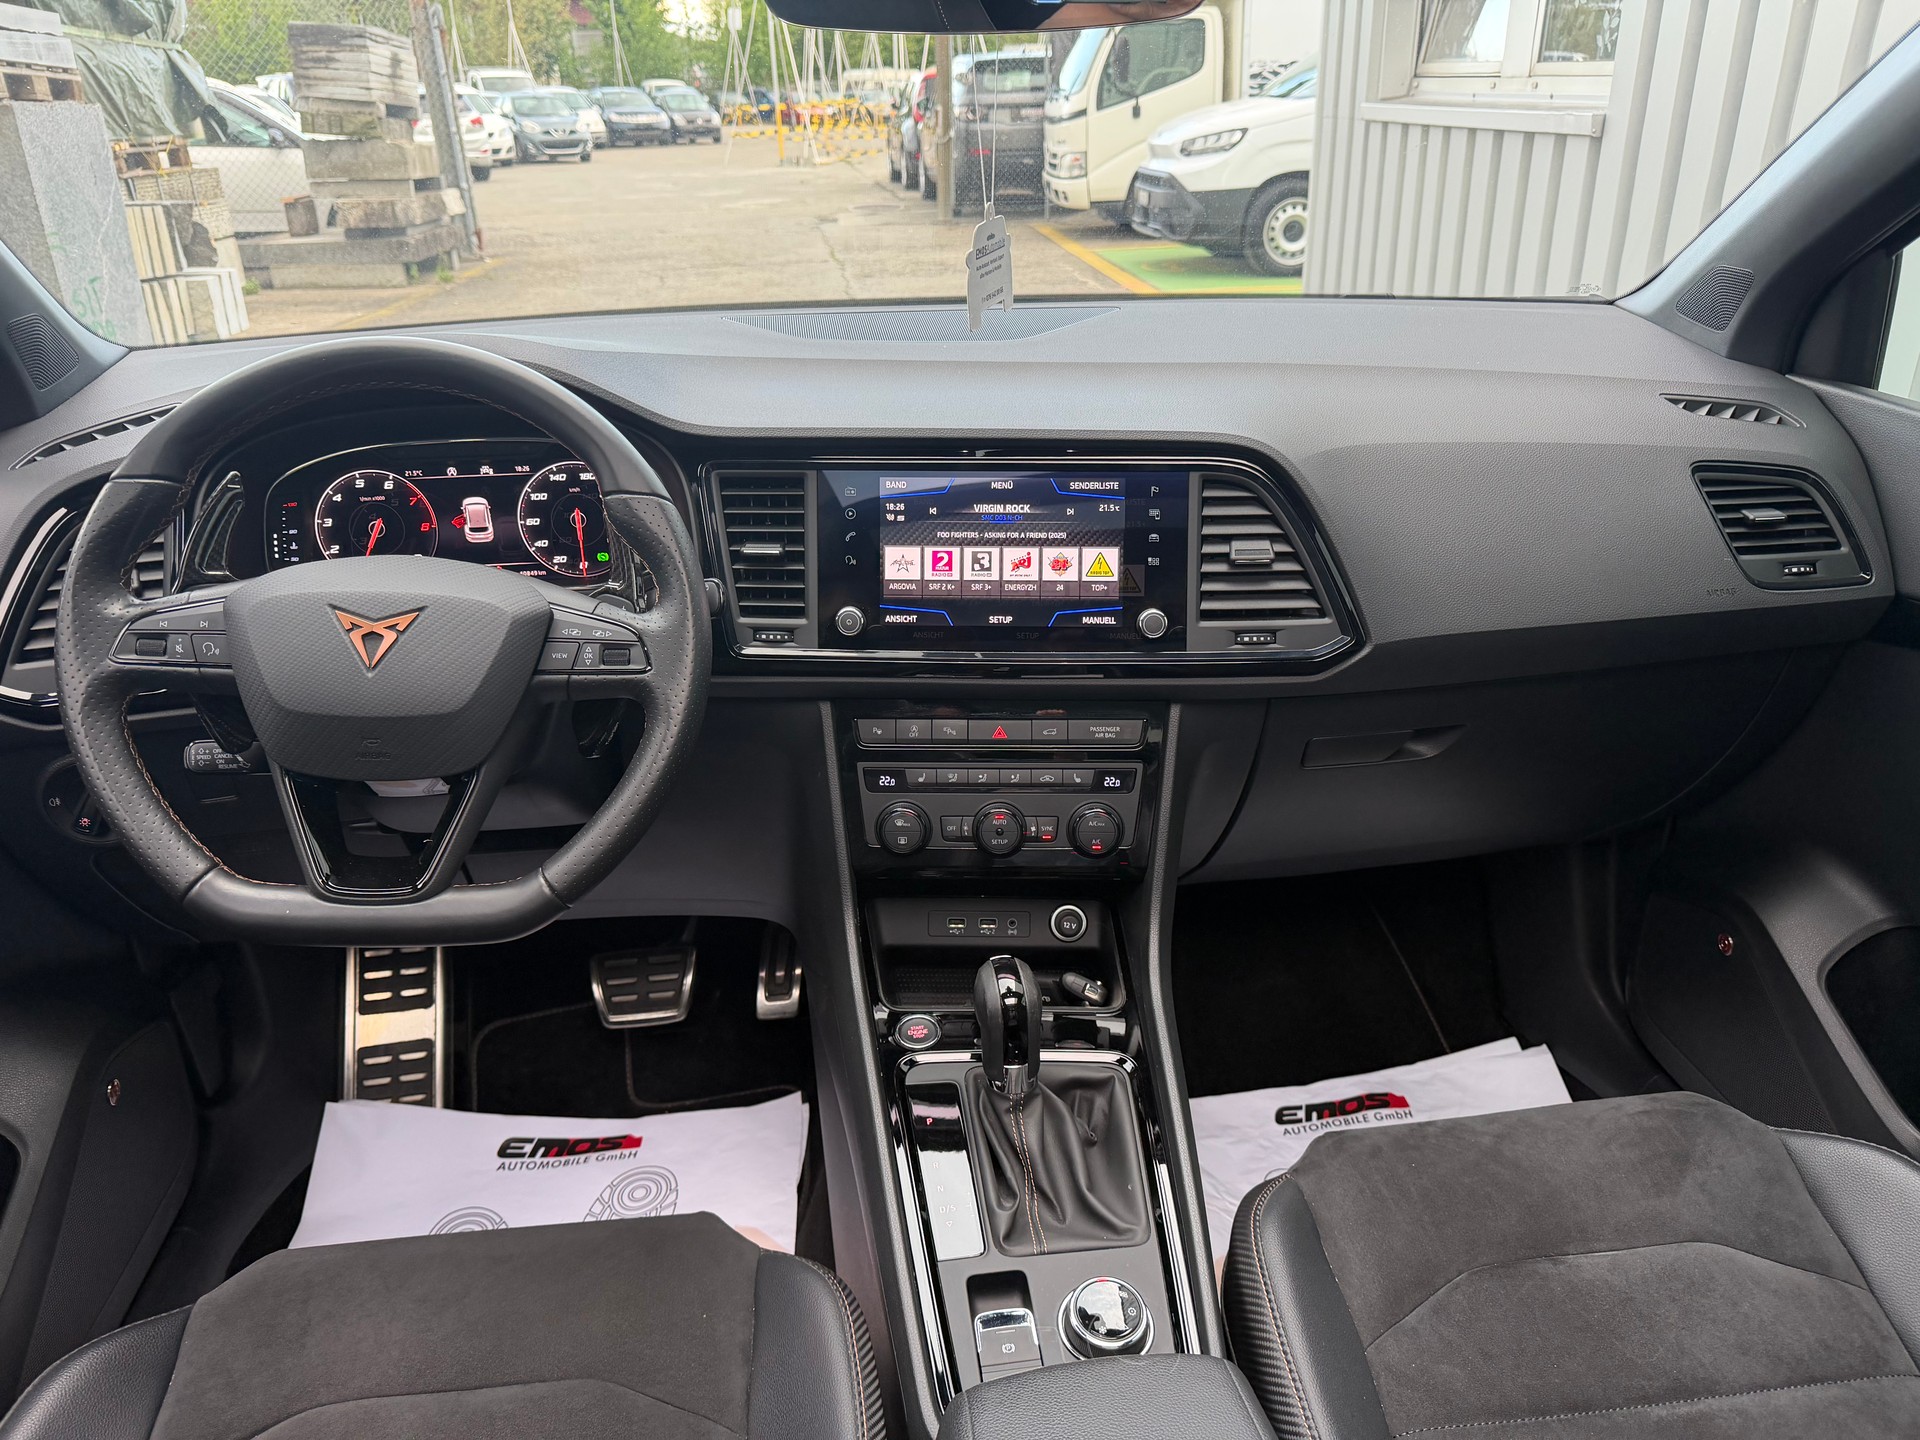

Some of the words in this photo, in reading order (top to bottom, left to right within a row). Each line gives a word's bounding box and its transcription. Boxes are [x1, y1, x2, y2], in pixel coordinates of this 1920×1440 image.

[549, 473, 567, 481] 140
[355, 479, 365, 488] 5
[384, 480, 394, 489] 6
[885, 480, 907, 489] BAND
[991, 480, 1014, 490] MENÜ
[1069, 481, 1120, 490] SENDERLISTE
[332, 493, 342, 502] 4
[409, 497, 417, 506] 7
[530, 493, 548, 501] 100
[885, 502, 905, 511] 18:26
[973, 503, 1004, 513] VIRGIN
[1006, 503, 1031, 514] ROCK
[322, 518, 333, 527] 3
[526, 518, 541, 526] 60
[420, 522, 430, 532] 8
[1048, 531, 1067, 539] (2025)
[329, 545, 340, 553] 2
[553, 555, 567, 563] 20
[936, 552, 949, 567] 2
[973, 552, 990, 571] 3
[579, 561, 588, 569] 0
[889, 582, 916, 590] ARGOVIA
[928, 583, 941, 591] SRF
[971, 583, 983, 591] SRF
[1004, 583, 1037, 591] ENERGYZH
[885, 615, 918, 623] ANSICHT
[988, 615, 1013, 624] SETUP
[1082, 616, 1117, 625] MANUELL
[1063, 921, 1071, 929] 12
[926, 1118, 933, 1126] P
[1282, 1113, 1370, 1137] AUTOMOBILE
[1373, 1110, 1414, 1122] GmbH
[496, 1155, 590, 1172] AUTOMOBILE
[595, 1150, 639, 1163] GmbH
[940, 1204, 956, 1214] D/S
